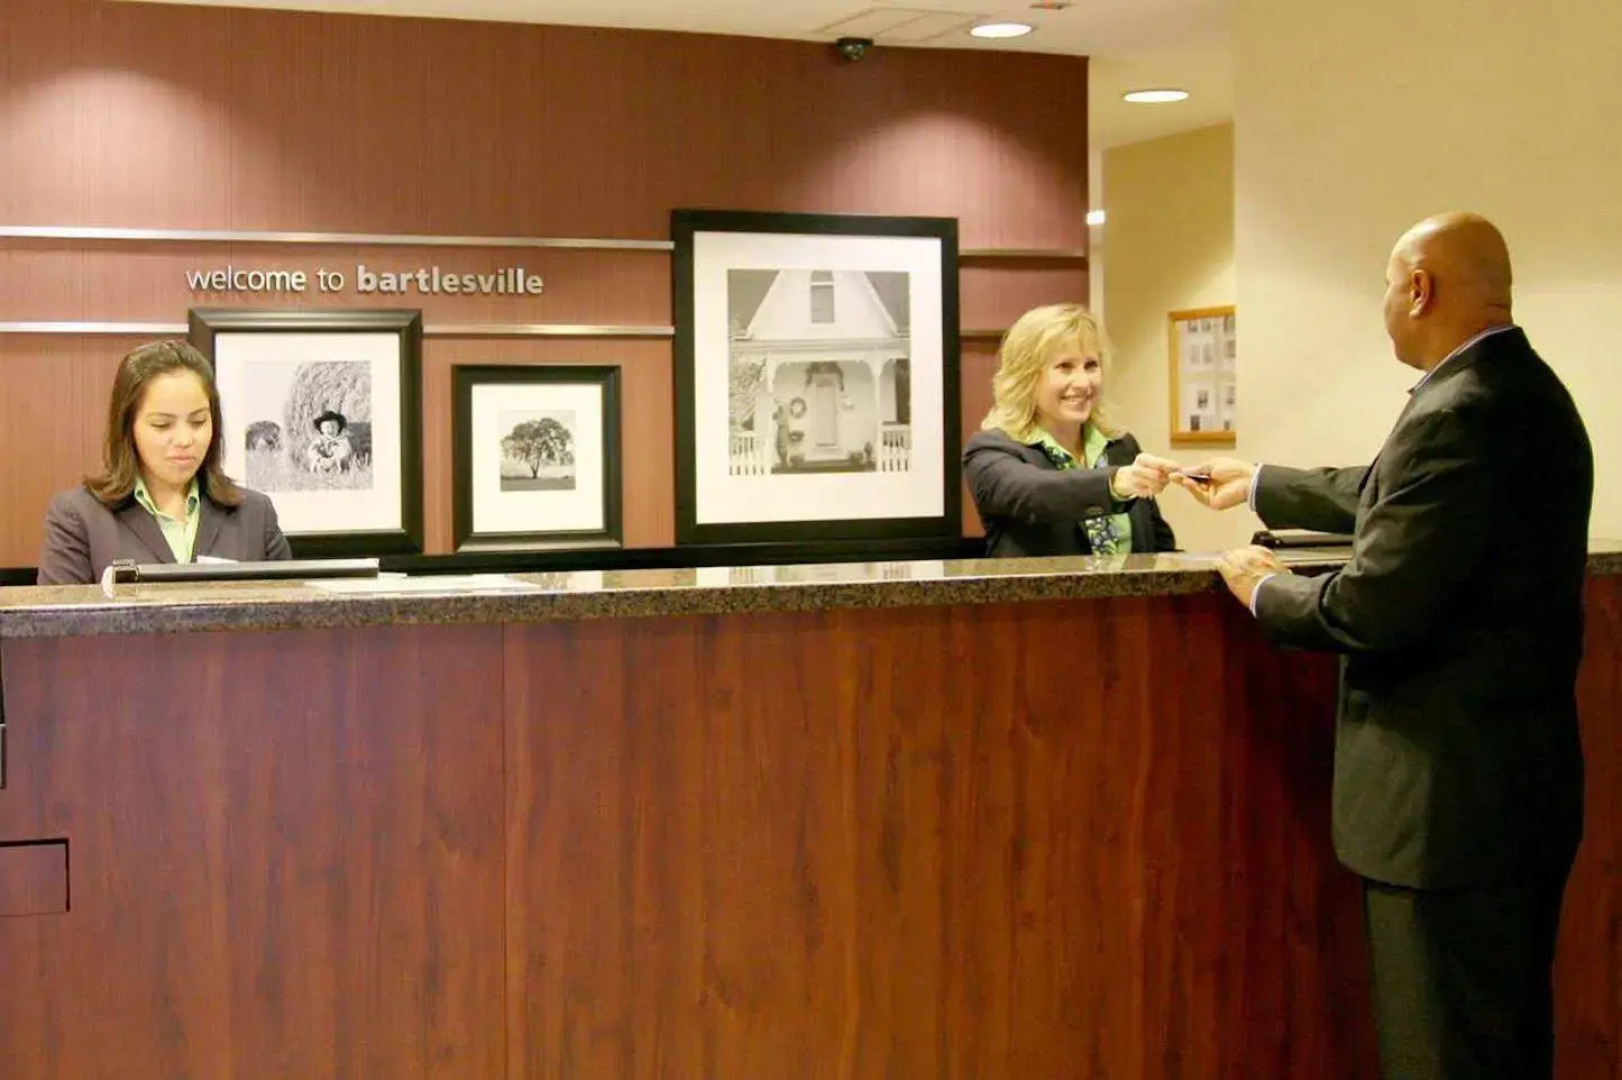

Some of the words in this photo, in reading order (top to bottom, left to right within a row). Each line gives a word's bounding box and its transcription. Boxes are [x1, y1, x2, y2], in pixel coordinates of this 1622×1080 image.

[186, 265, 306, 291] welcome
[317, 269, 345, 292] to
[357, 265, 544, 295] bartlesville
